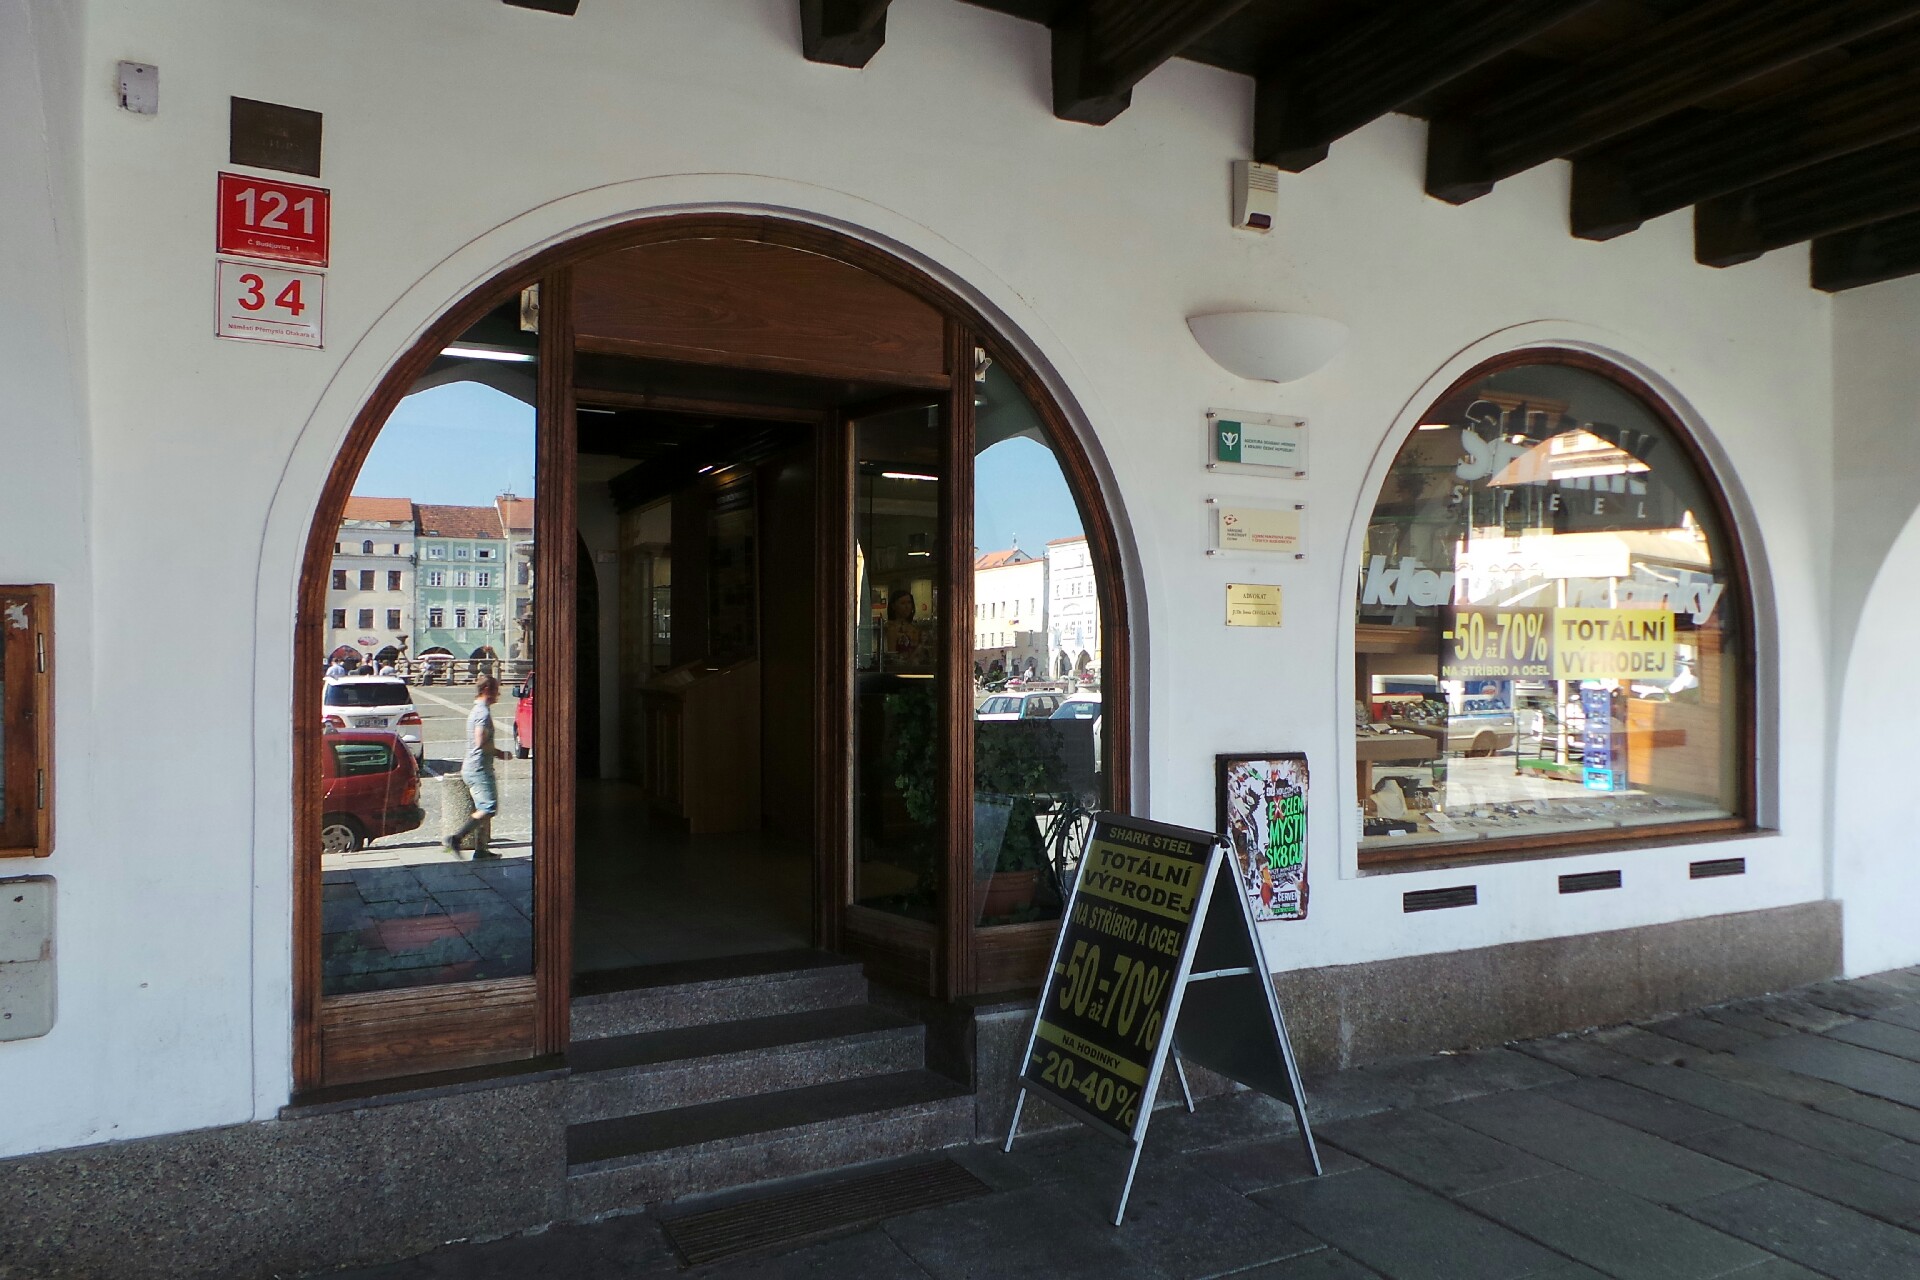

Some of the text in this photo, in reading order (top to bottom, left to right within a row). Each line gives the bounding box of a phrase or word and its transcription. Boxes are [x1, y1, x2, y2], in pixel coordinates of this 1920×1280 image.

[235, 187, 314, 235] 121
[237, 273, 305, 316] 34
[1453, 485, 1646, 519] STEEL
[1562, 615, 1666, 642] TOTÁLNÍ
[1486, 643, 1498, 658] až
[1561, 646, 1666, 673] VÝPRODEJ
[1442, 663, 1551, 677] NA STŘÍBRO A OCEL
[1109, 827, 1193, 856] SHARK STEEL
[1100, 850, 1194, 888] TOTÁLNÍ
[1084, 869, 1195, 915] VÝPRODEJ
[1073, 901, 1181, 957] NA STŘÍBRO A OCEL
[1088, 1000, 1104, 1022] až
[1061, 1034, 1121, 1070] NA HODINKY
